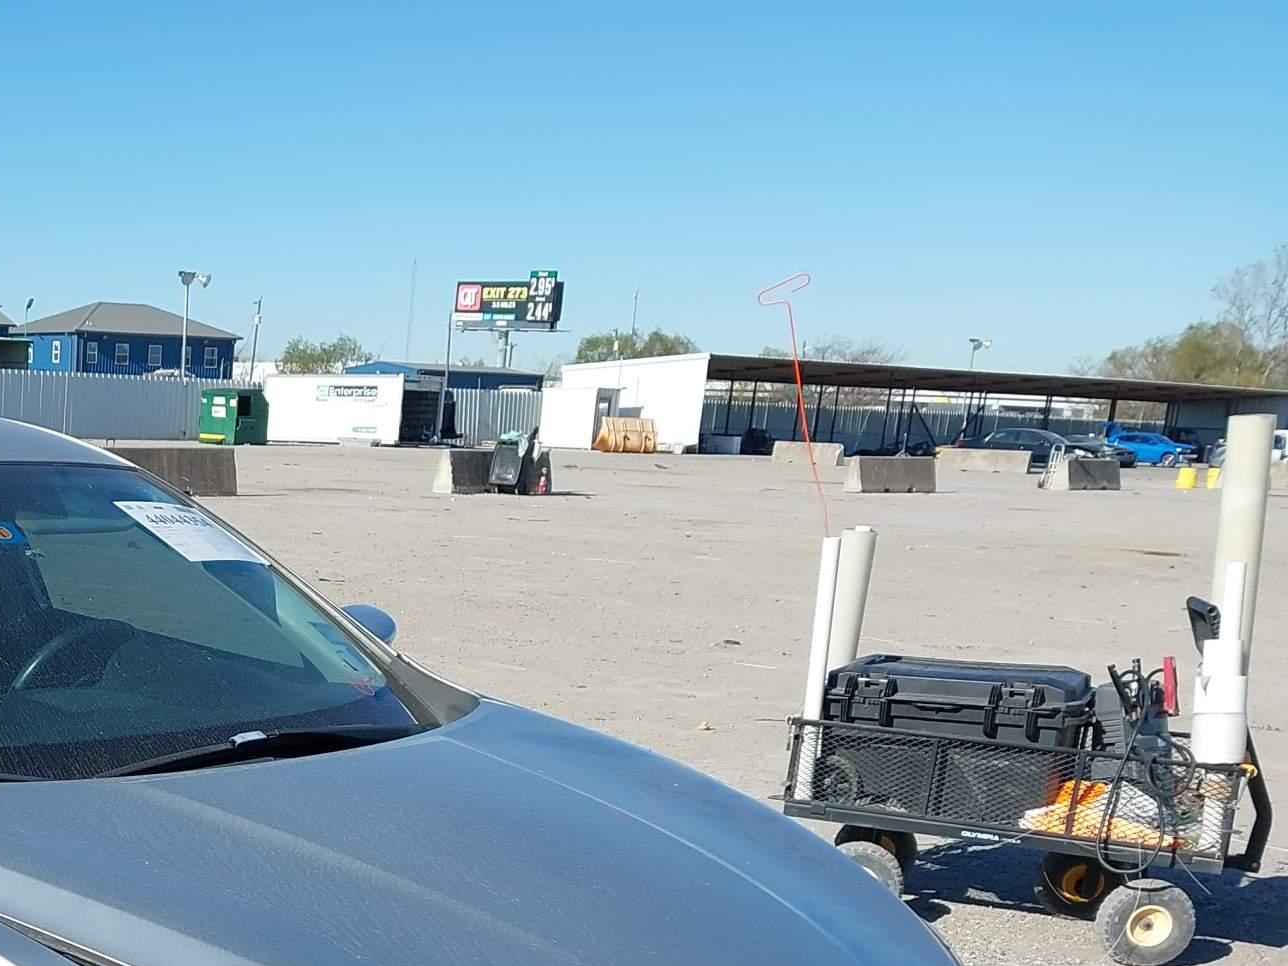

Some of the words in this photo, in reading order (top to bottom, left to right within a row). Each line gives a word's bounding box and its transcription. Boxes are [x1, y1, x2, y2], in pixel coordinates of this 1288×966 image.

[482, 287, 507, 299] EXIT
[507, 286, 528, 299] 273
[328, 386, 378, 398] Enterprise
[961, 831, 1000, 841] OLYMPIA
